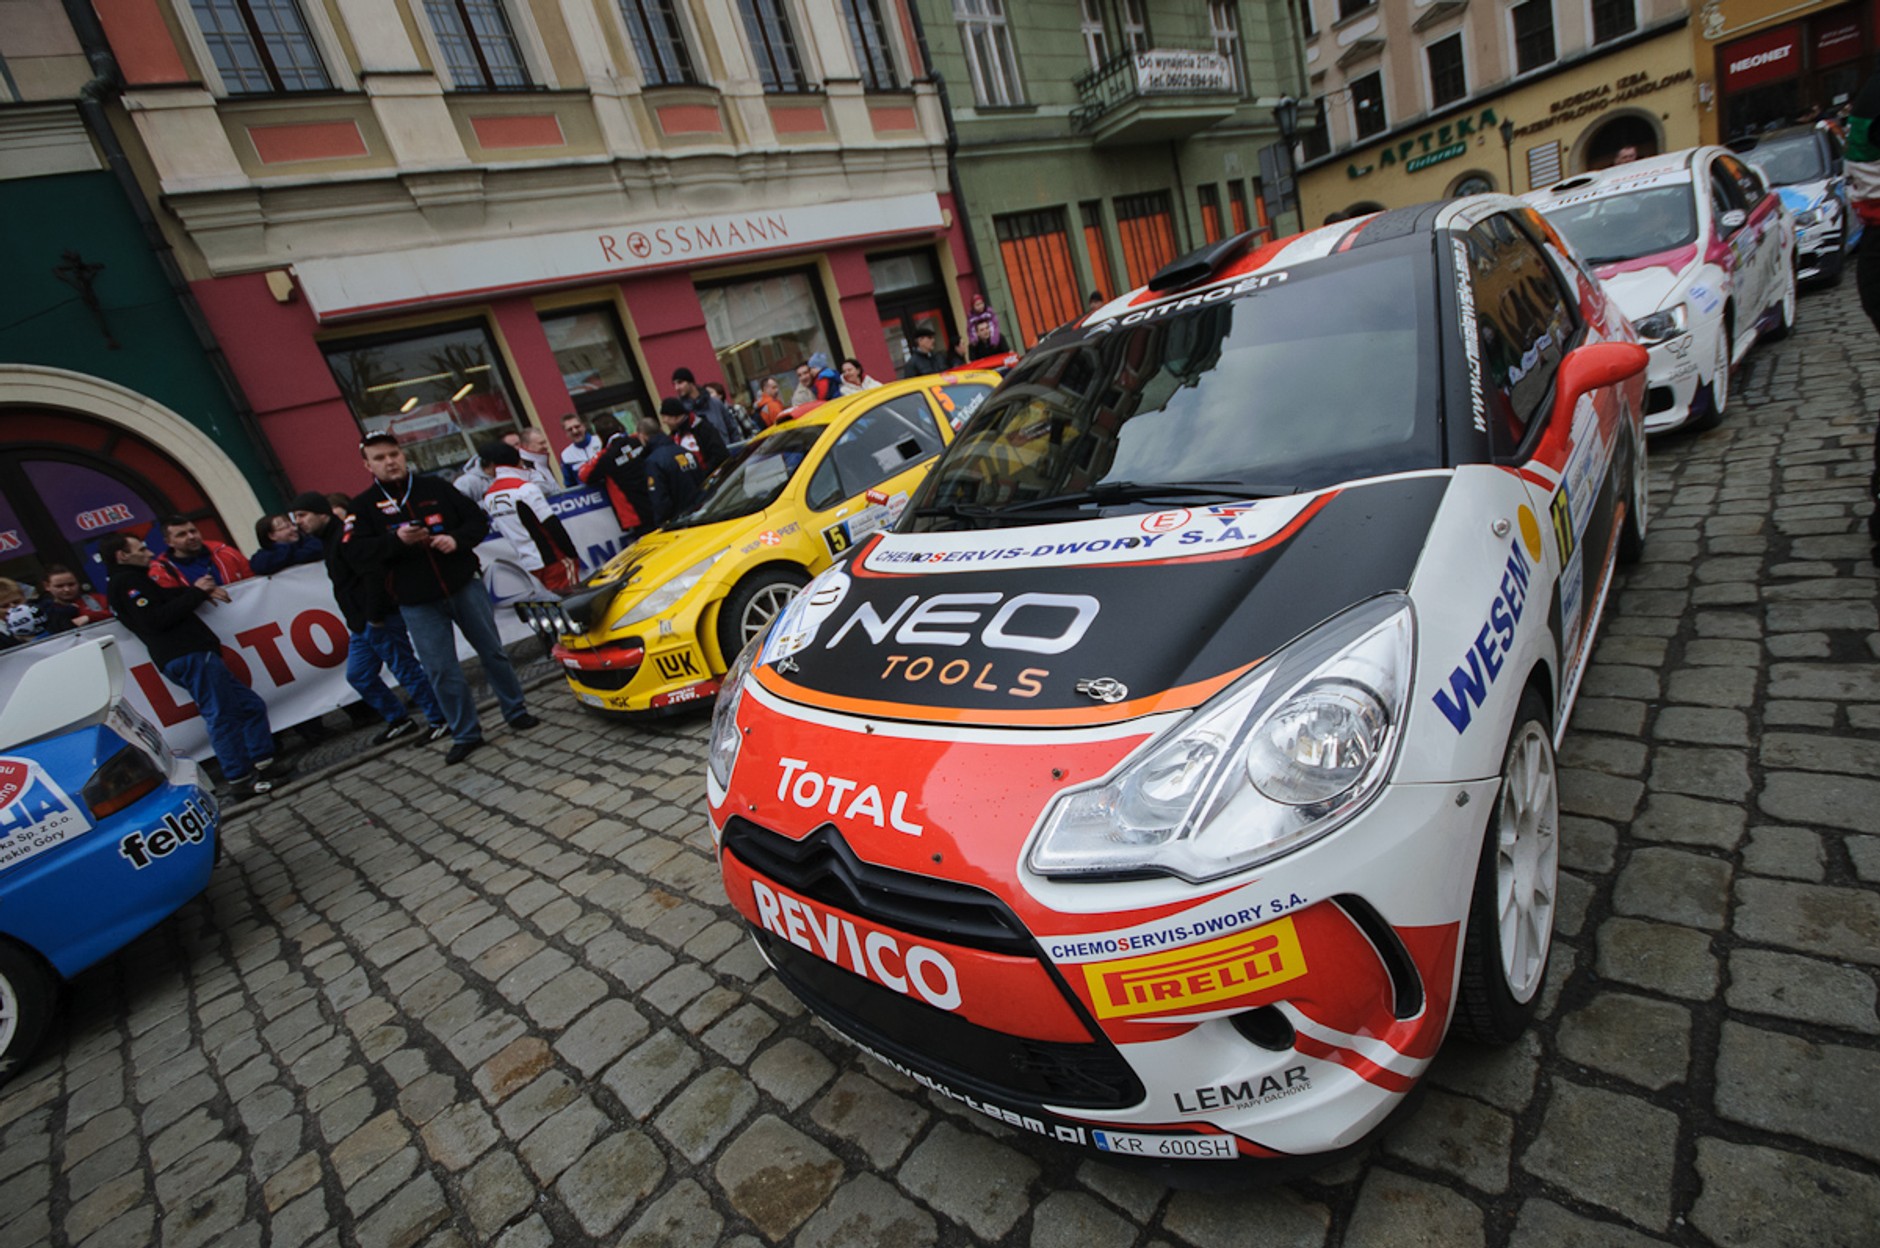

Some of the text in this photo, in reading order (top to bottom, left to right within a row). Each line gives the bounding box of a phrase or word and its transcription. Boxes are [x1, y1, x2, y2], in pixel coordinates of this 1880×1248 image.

[1617, 70, 1648, 90] IZBA
[1730, 44, 1792, 74] NEONET
[1379, 107, 1498, 170] APTEKA
[599, 215, 789, 263] ROSSMANN
[1121, 270, 1289, 327] CITROËN
[931, 385, 956, 412] 5
[829, 525, 847, 552] 5
[876, 526, 1258, 563] CHEMOSERVIS-DWORY S.A.
[1552, 485, 1574, 573] 17
[826, 591, 1101, 655] NEO
[1432, 538, 1531, 735] WESEM
[881, 655, 1050, 699] TOOLS
[776, 757, 924, 837] TOTAL
[33, 829, 65, 848] Góry
[751, 879, 963, 1012] REVICO
[1052, 892, 1309, 959] CHEMOSERVIS-DWORY S.A.
[1102, 934, 1284, 1007] PIRELLI
[1173, 1065, 1310, 1114] LEMAR
[1236, 1080, 1314, 1112] PAPY DACHOWE
[1112, 1137, 1232, 1157] KR 600SH
